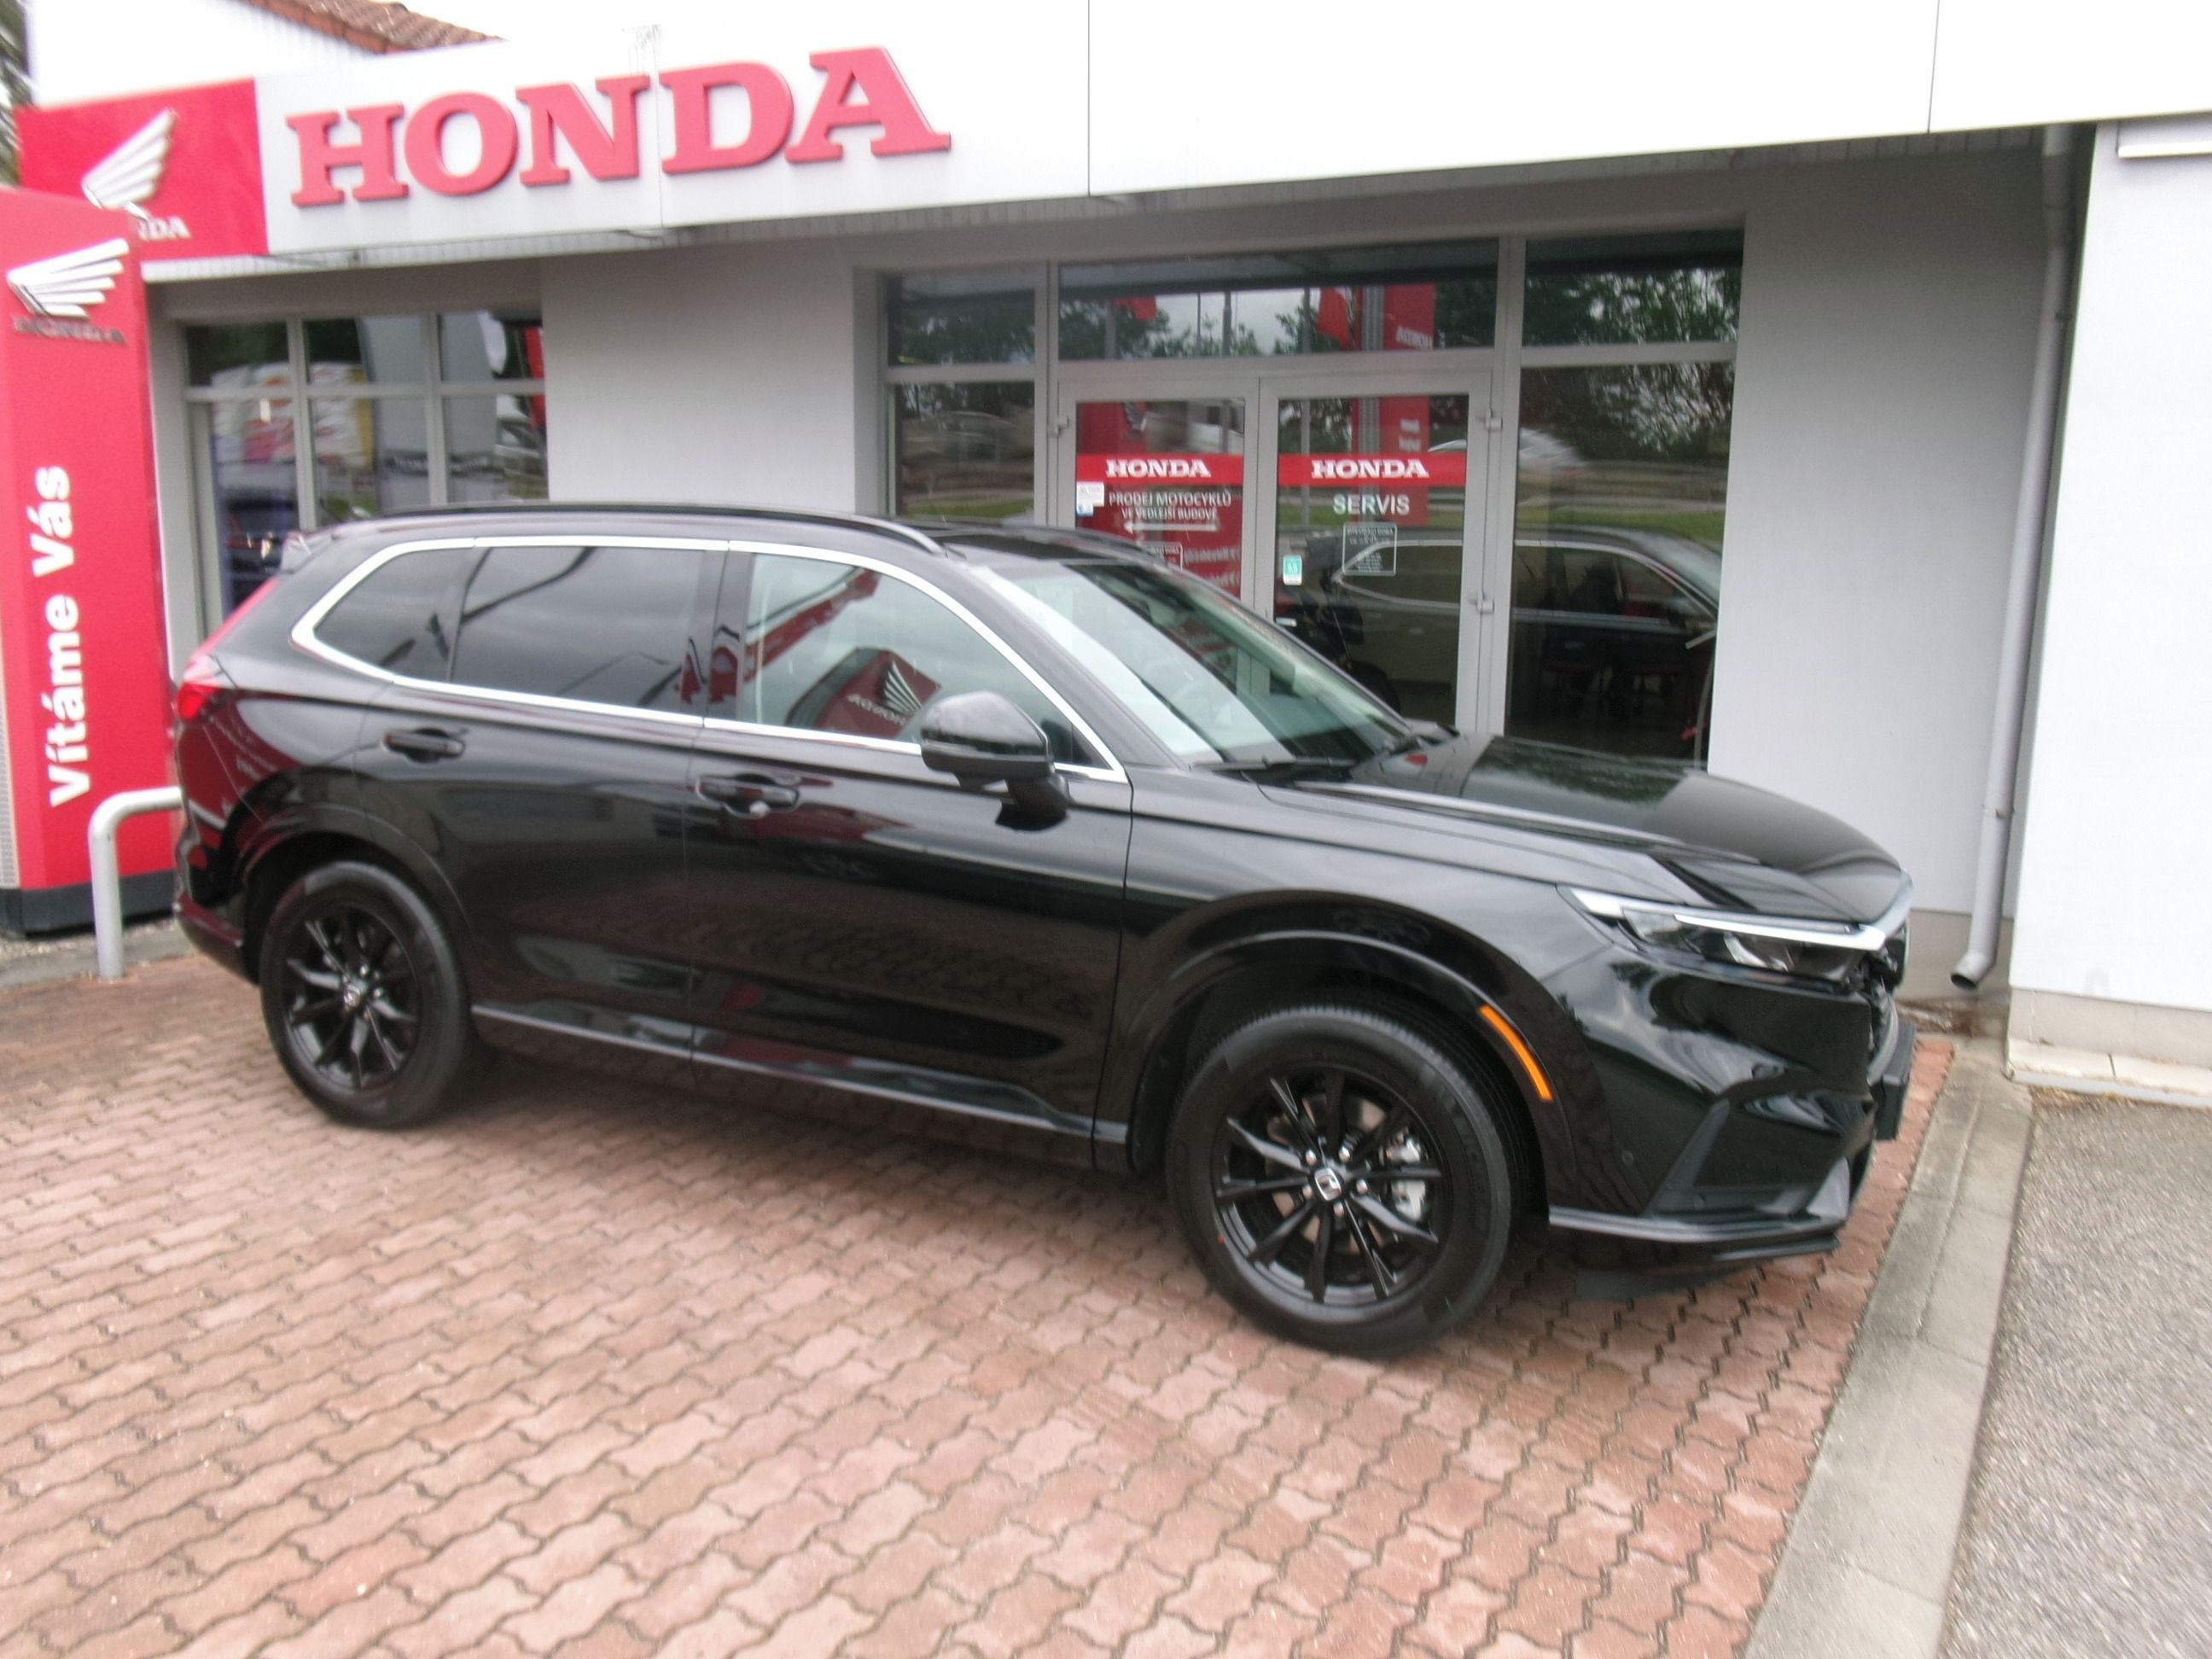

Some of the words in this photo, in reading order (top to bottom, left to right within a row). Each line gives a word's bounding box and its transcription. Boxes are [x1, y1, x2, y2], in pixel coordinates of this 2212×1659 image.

[286, 46, 952, 207] HONDA
[1106, 459, 1212, 478] HONDA
[1311, 459, 1429, 479] HONDA
[1109, 492, 1154, 506] PRODEJ
[1333, 494, 1410, 515] SERVIS
[26, 466, 75, 577] Vás
[41, 594, 90, 807] Vítáme
